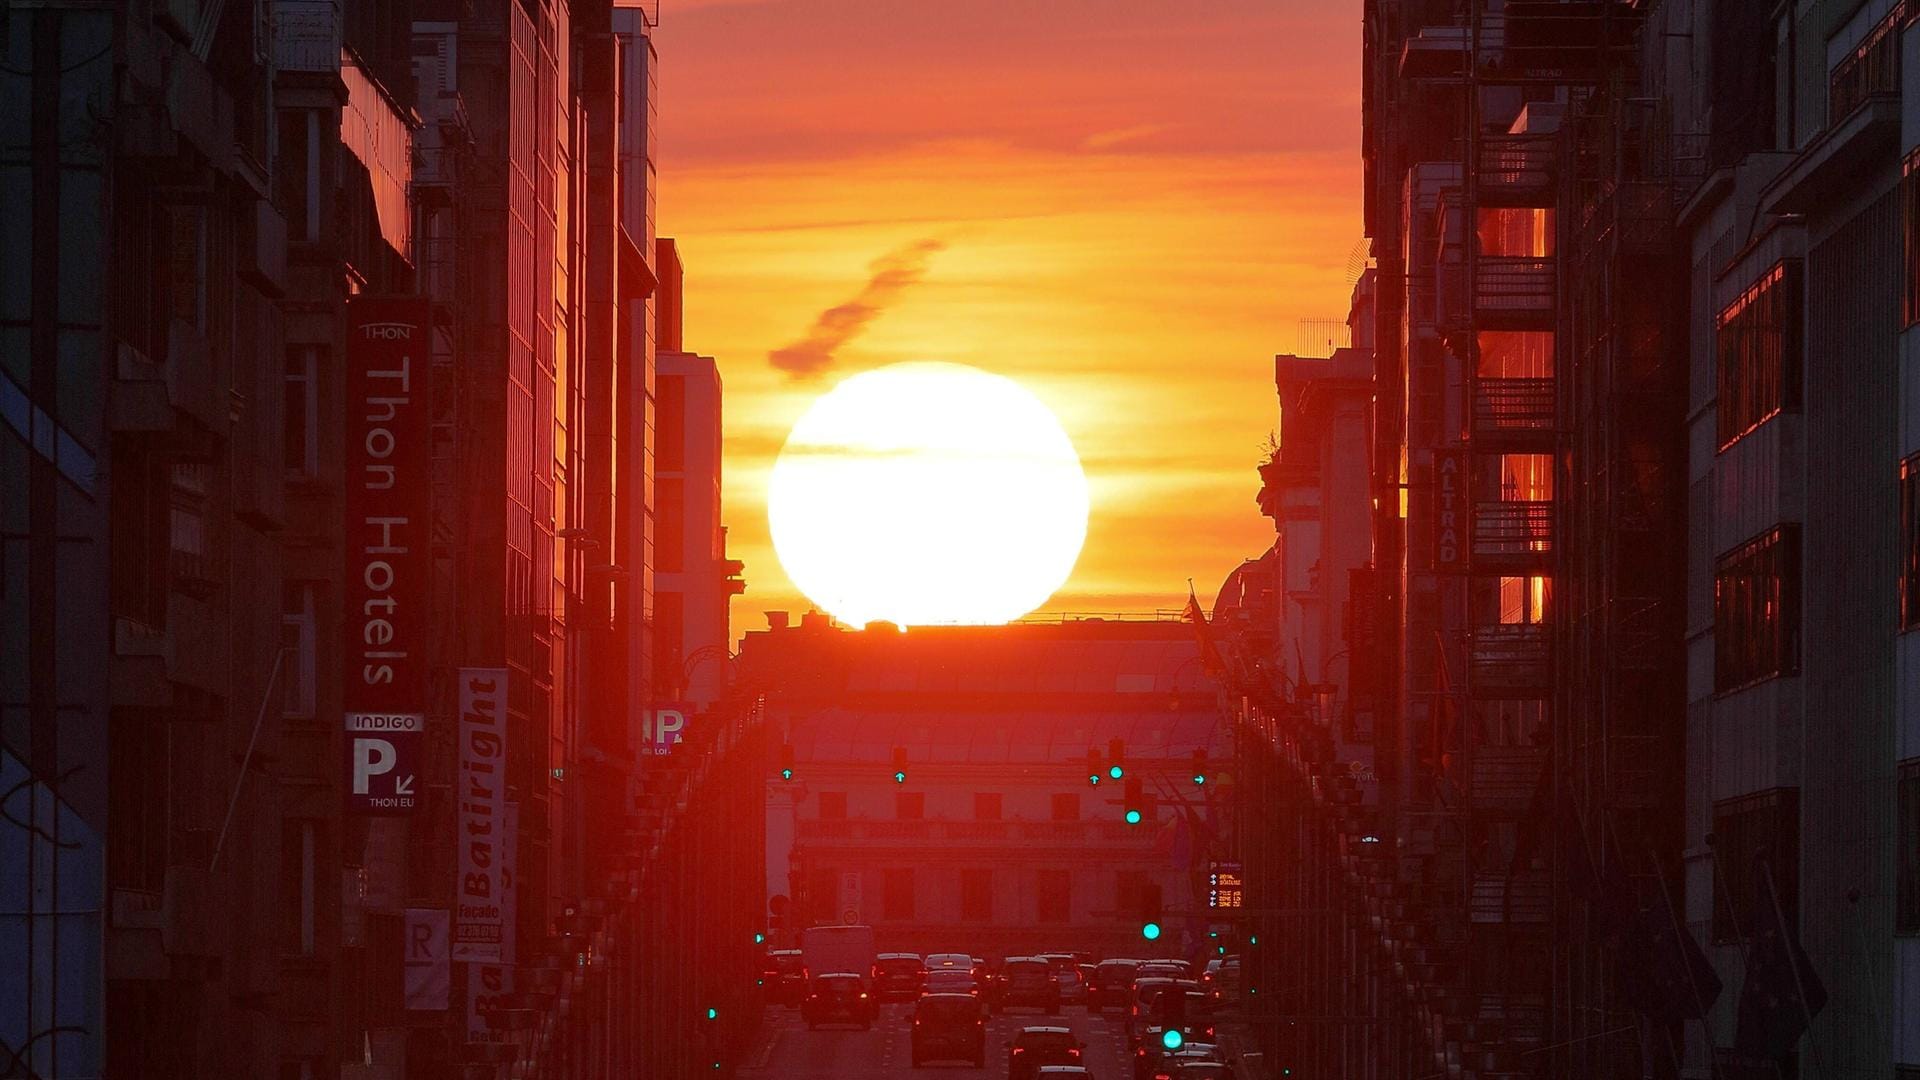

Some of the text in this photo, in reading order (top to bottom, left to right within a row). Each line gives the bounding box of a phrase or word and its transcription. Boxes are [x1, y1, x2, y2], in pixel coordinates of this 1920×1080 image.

[358, 323, 419, 341] THON
[364, 356, 410, 685] Thon Hotels
[1440, 456, 1457, 562] ALTRAD
[355, 716, 416, 730] INDIGO
[656, 709, 684, 744] P
[353, 737, 397, 795] P
[463, 676, 502, 898] Batiright
[369, 798, 415, 808] THON EU
